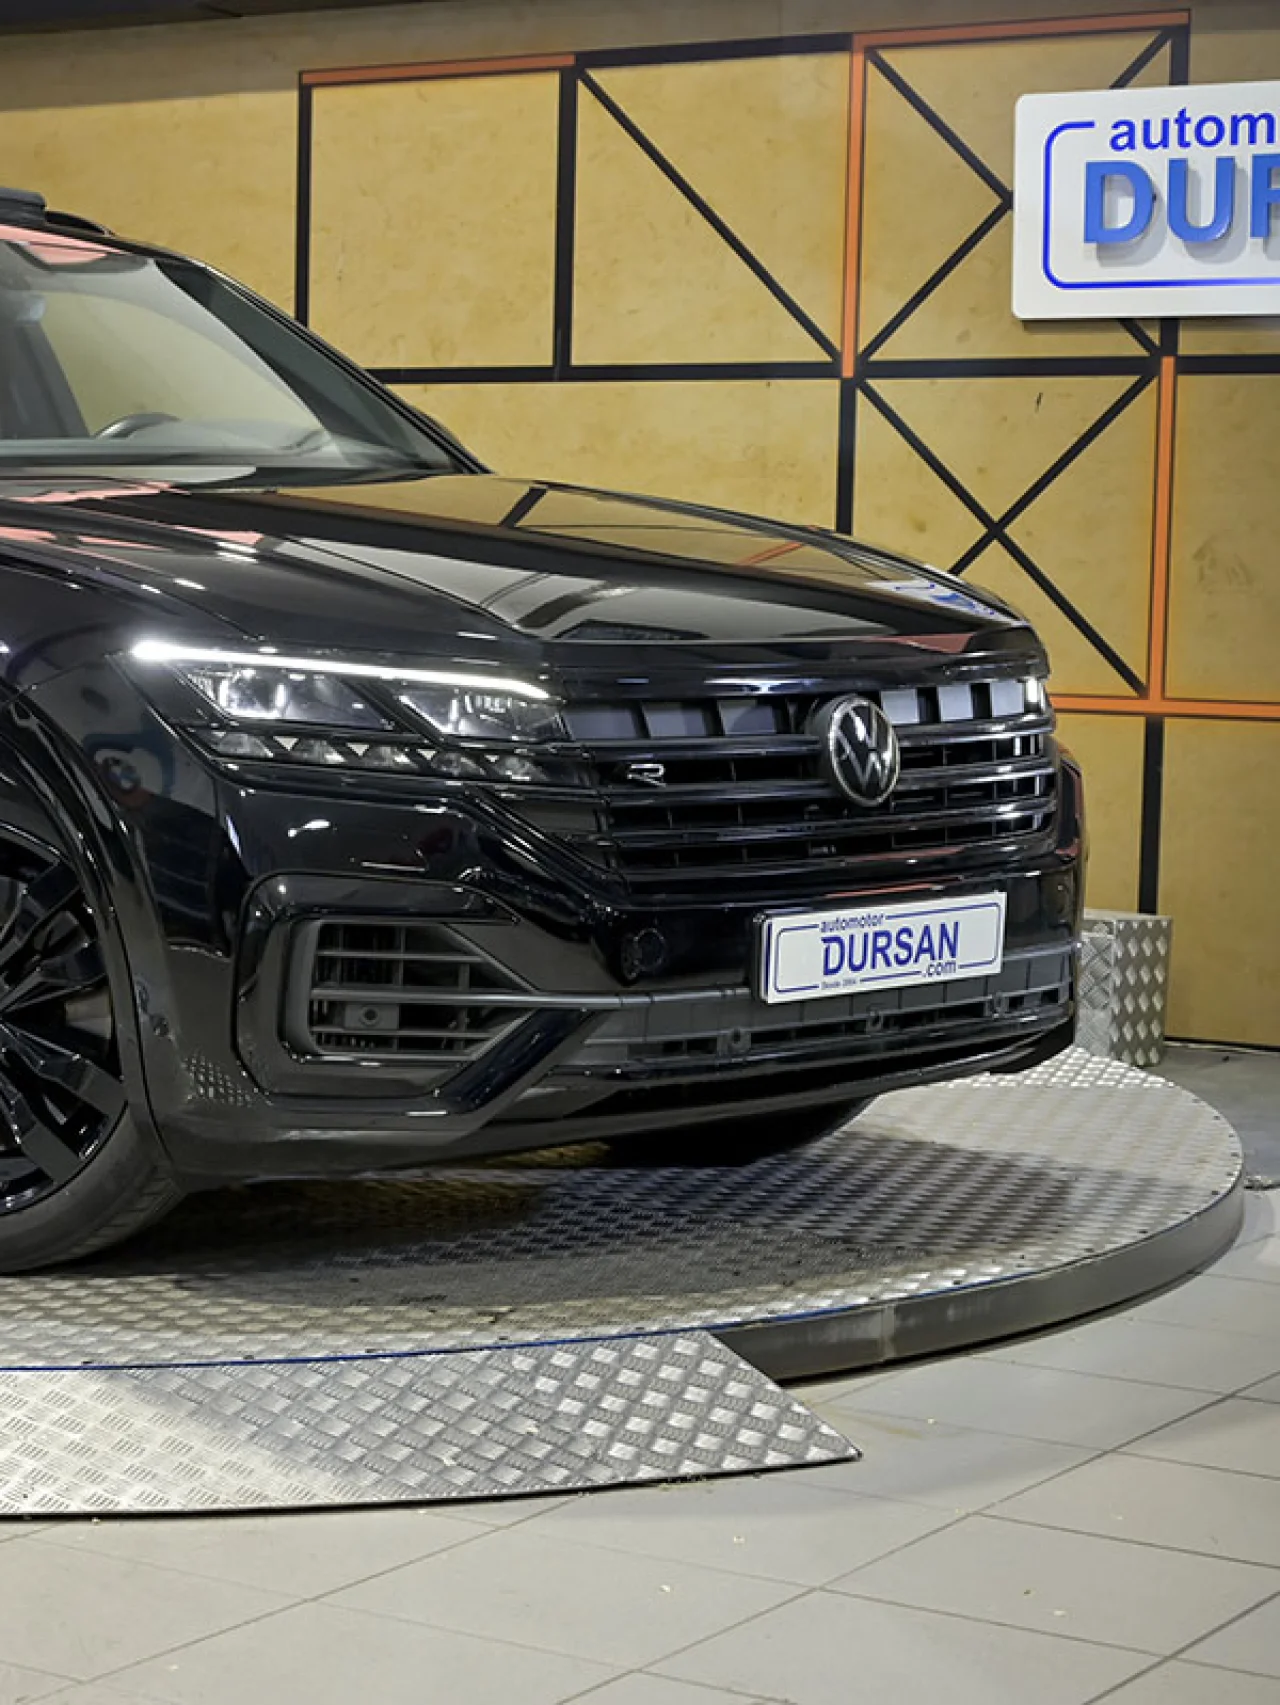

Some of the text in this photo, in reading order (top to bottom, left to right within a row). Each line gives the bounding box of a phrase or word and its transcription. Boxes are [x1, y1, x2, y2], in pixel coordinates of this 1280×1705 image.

[1109, 106, 1275, 152] autom
[820, 913, 885, 933] automotor
[821, 921, 960, 976] DURSAN
[922, 959, 957, 977] .com
